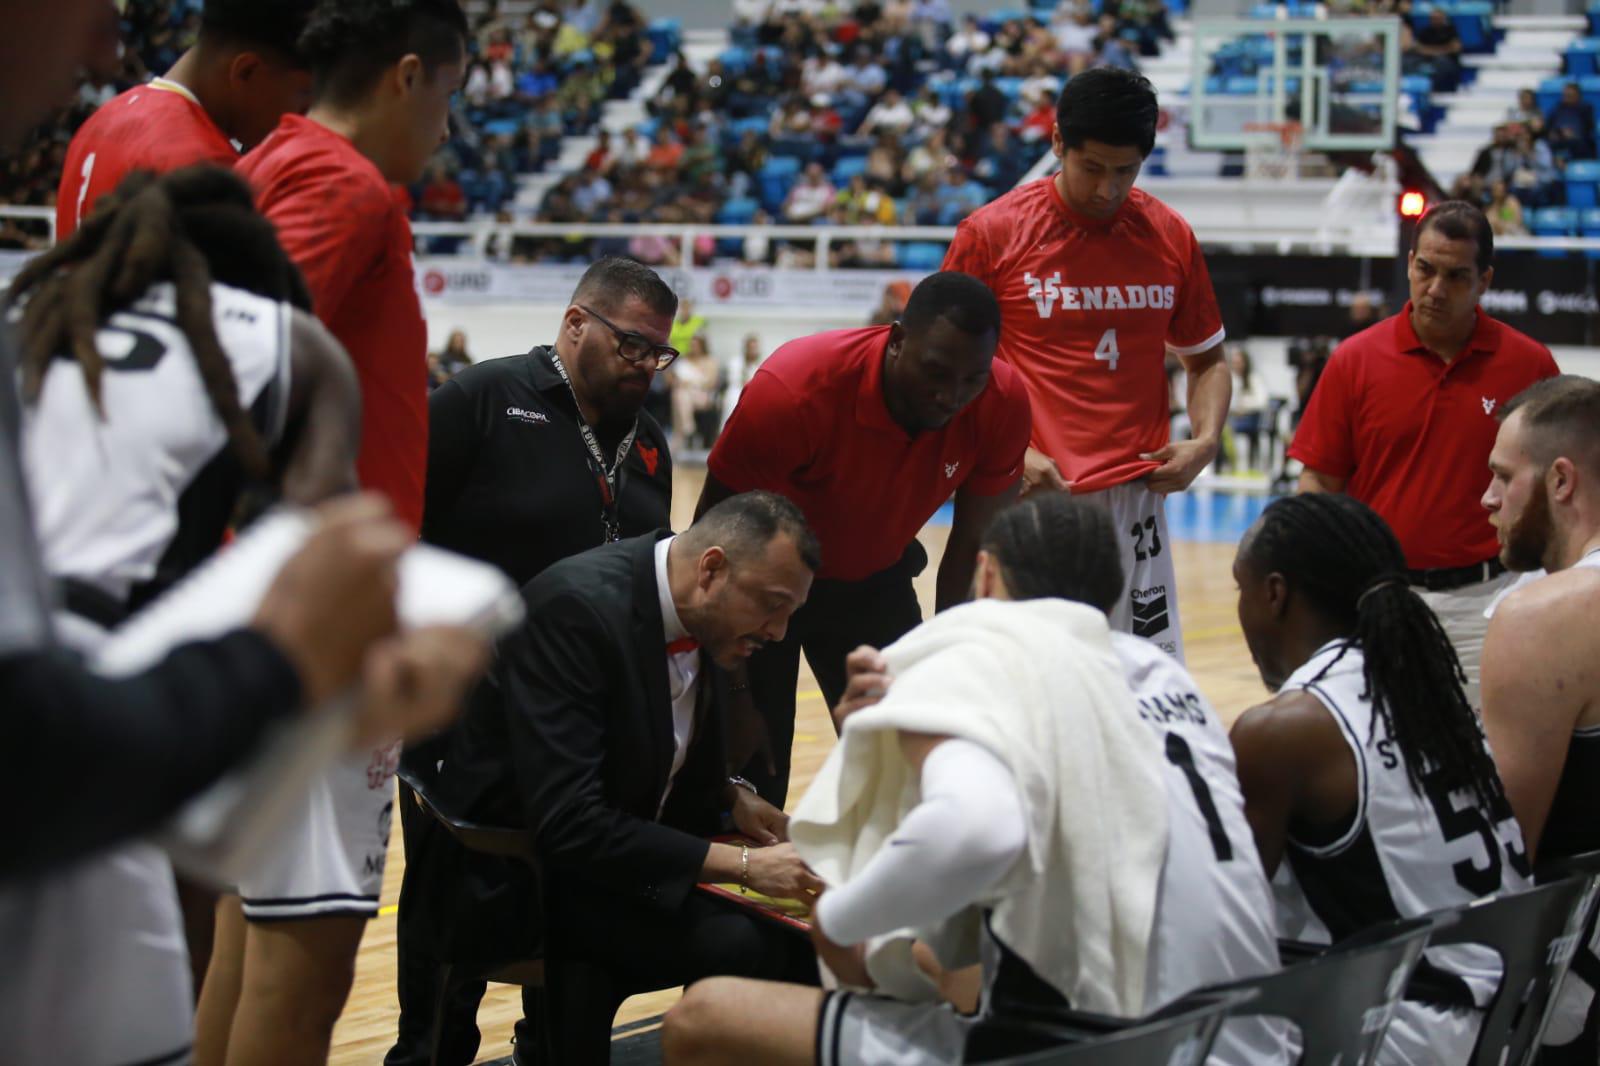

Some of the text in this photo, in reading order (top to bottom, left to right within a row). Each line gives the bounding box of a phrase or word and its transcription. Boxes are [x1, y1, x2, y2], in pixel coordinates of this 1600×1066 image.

[77, 152, 96, 229] 1
[1024, 271, 1175, 318] VENADOS
[1094, 328, 1120, 370] 4
[1131, 515, 1161, 561] 23
[1131, 584, 1166, 599] Cheron
[1165, 730, 1233, 862] 1
